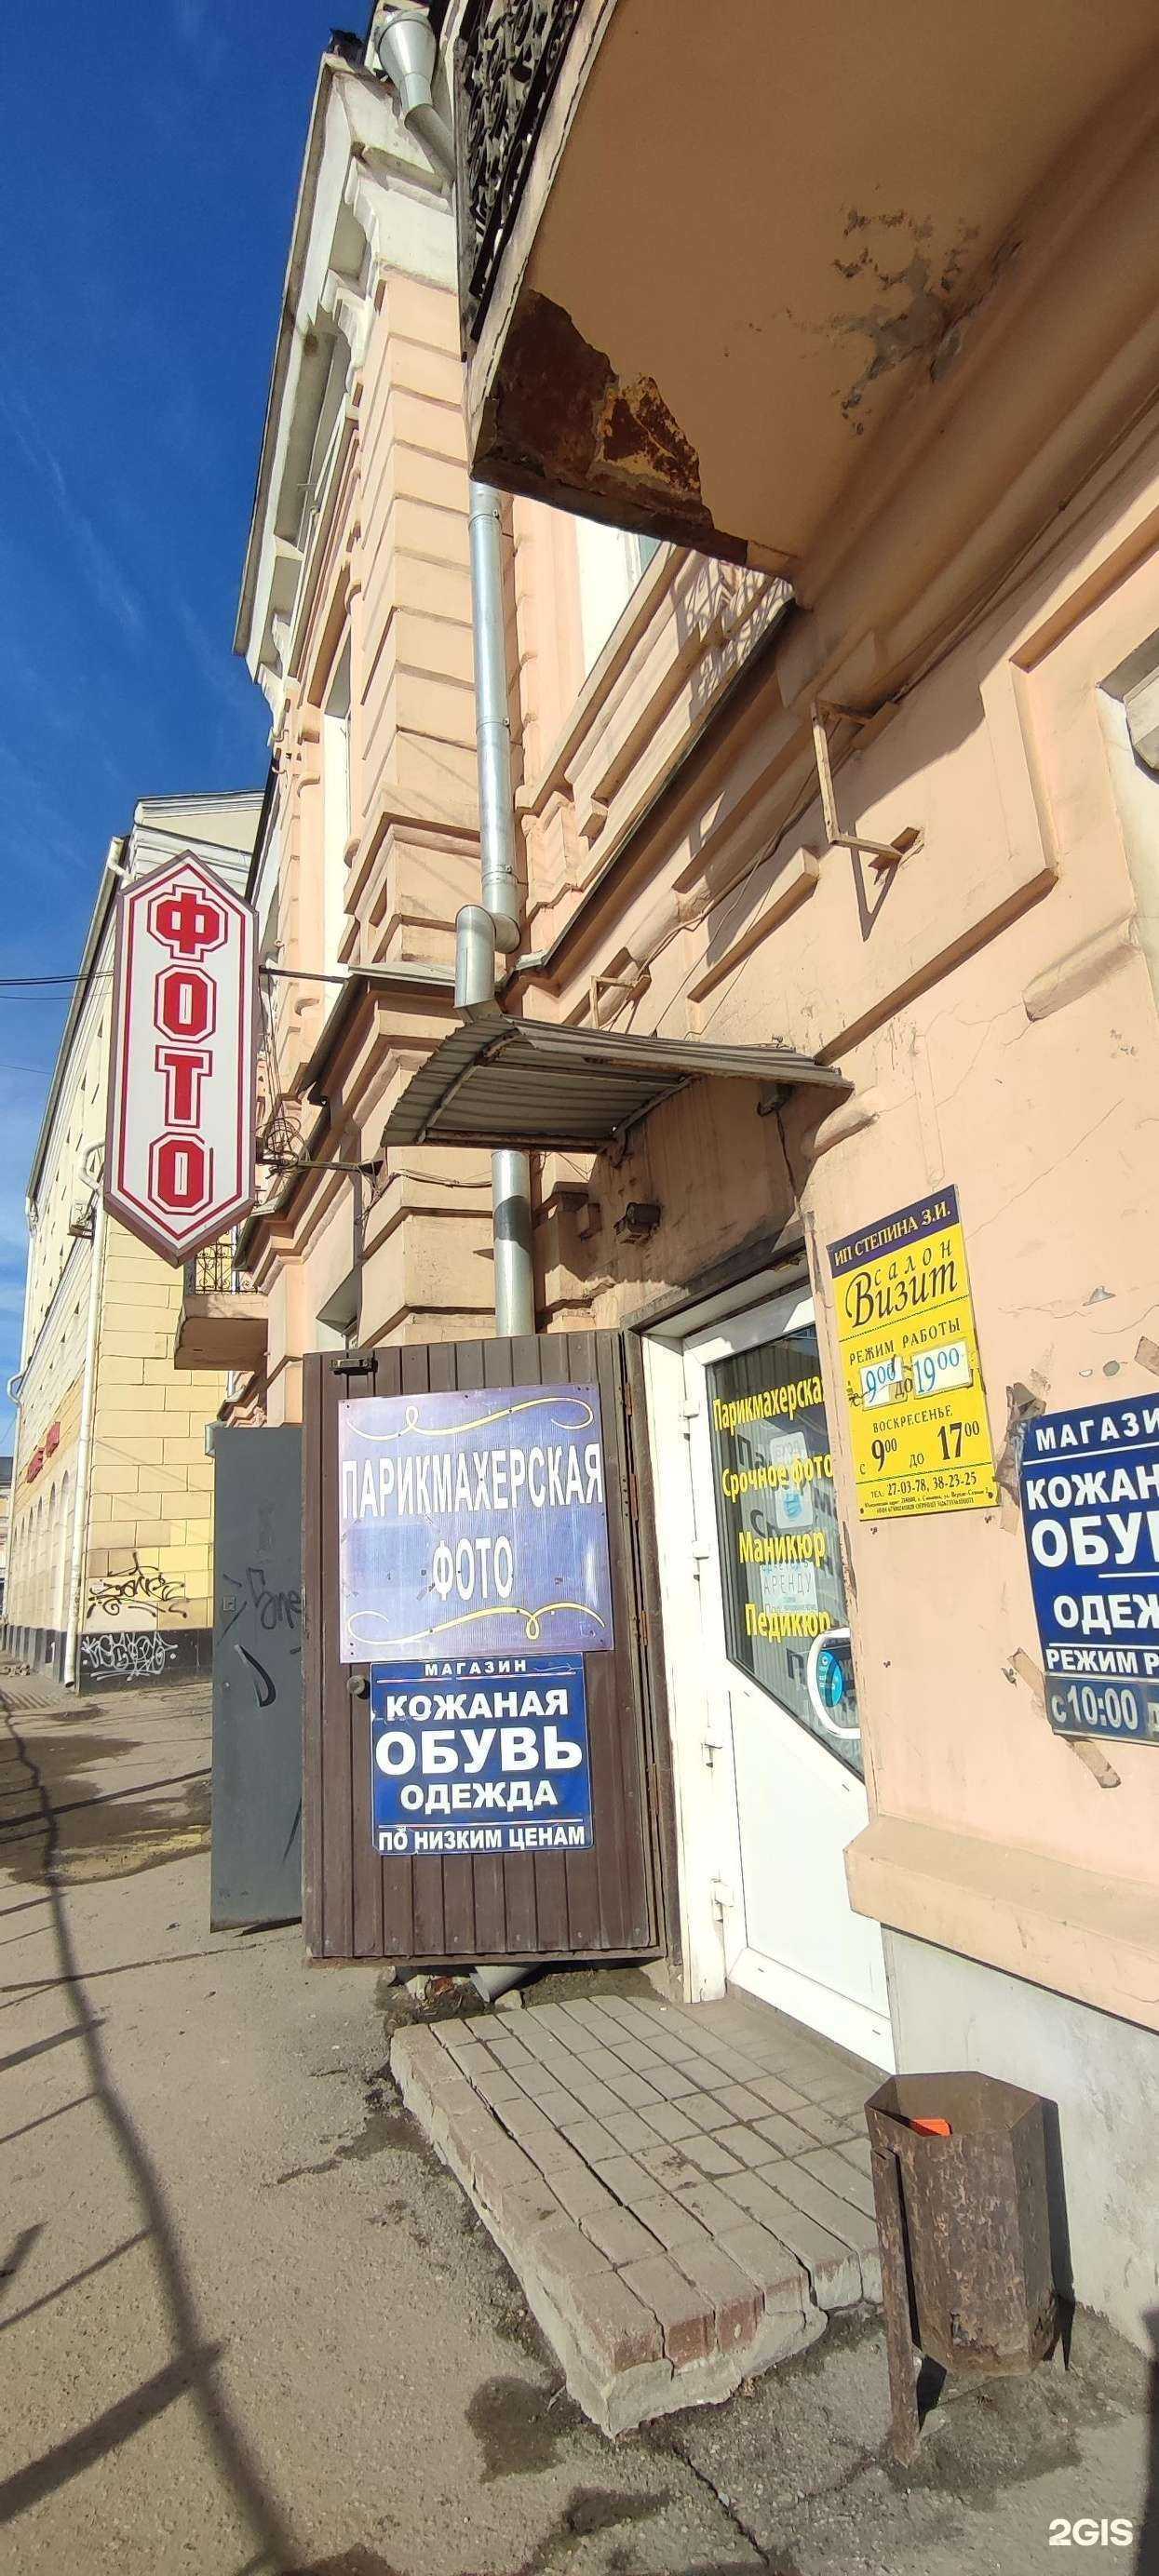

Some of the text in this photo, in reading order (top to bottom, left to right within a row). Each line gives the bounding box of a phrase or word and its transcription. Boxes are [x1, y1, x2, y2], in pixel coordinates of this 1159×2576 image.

[147, 885, 228, 1215] ФОТО
[834, 1201, 951, 1267] ИП СТЕПИНА З.И.
[874, 1239, 951, 1286] салон
[845, 1260, 958, 1328] Визит
[849, 1318, 961, 1365] РЕЖИМ РАБОТЫ
[713, 1375, 824, 1436] Парикмахерска
[872, 1404, 952, 1433] ВОСКРЕСЕНЬЕ
[1035, 1407, 1159, 1452] МАГАЗИ
[342, 1442, 603, 1519] ПАРИКМАХЕРСКАЯ
[722, 1453, 834, 1503] Срочное фото
[871, 1471, 977, 1499] ТЕЛ. 27-03-78, 38-23-25
[1026, 1463, 1159, 1510] КОЖАН
[432, 1536, 513, 1601] ФОТО
[738, 1531, 826, 1567] Маникюр
[763, 1572, 812, 1595] АРЕНДУ
[745, 1603, 831, 1643] Педикюр
[1053, 1593, 1159, 1635] ОДЕЖ
[425, 1659, 527, 1676] МАГАЗИН
[1045, 1648, 1139, 1674] РЕЖИМ
[386, 1689, 569, 1721] КОЖАНАЯ
[1067, 1684, 1139, 1731] 10:00
[375, 1725, 583, 1776] ОБУВЬ
[400, 1779, 559, 1815] ОДЕЖДА
[379, 1826, 586, 1851] ПО НИЗКИМ ЦЕНАМ
